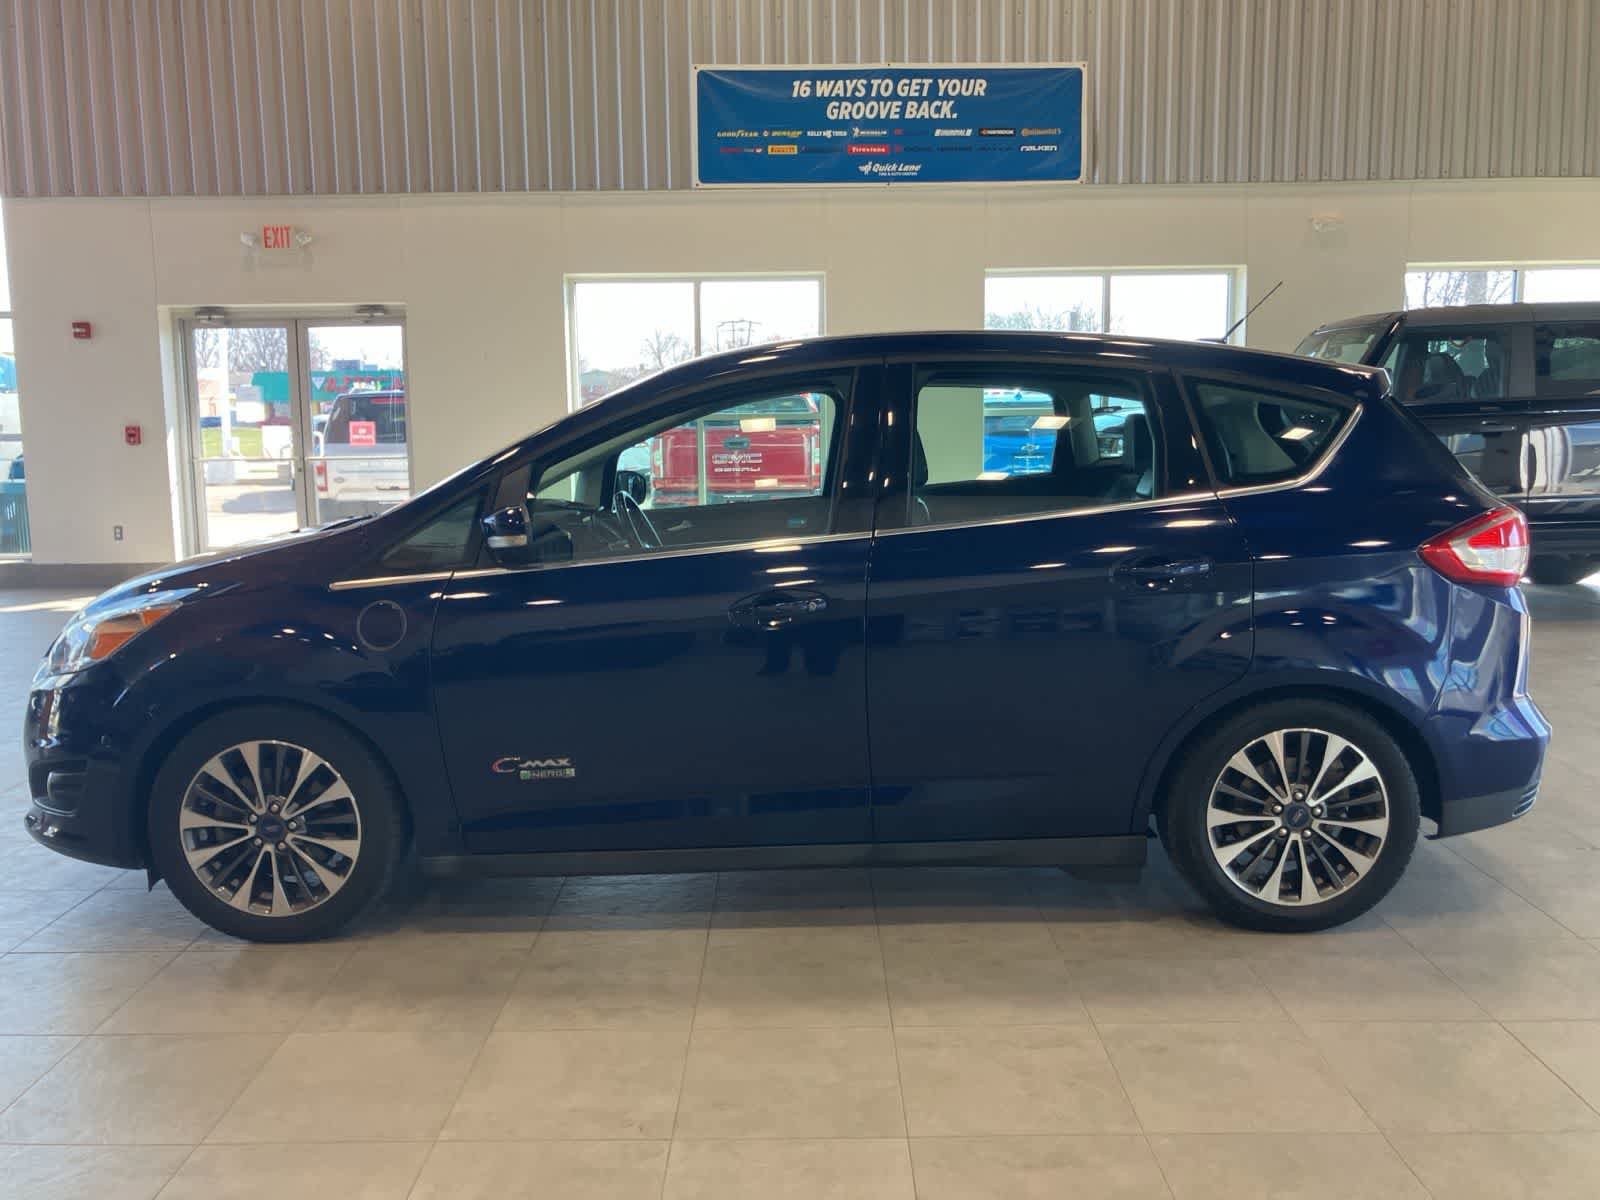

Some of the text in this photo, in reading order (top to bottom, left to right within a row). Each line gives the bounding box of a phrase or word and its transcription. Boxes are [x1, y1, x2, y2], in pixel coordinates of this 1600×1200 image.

[792, 78, 987, 98] 16 WAYS TO GET YOUR
[826, 100, 958, 120] GROOVE BACK.
[1020, 144, 1058, 152] FALKEN
[872, 162, 922, 173] Quick Lane
[263, 225, 292, 249] EXIT
